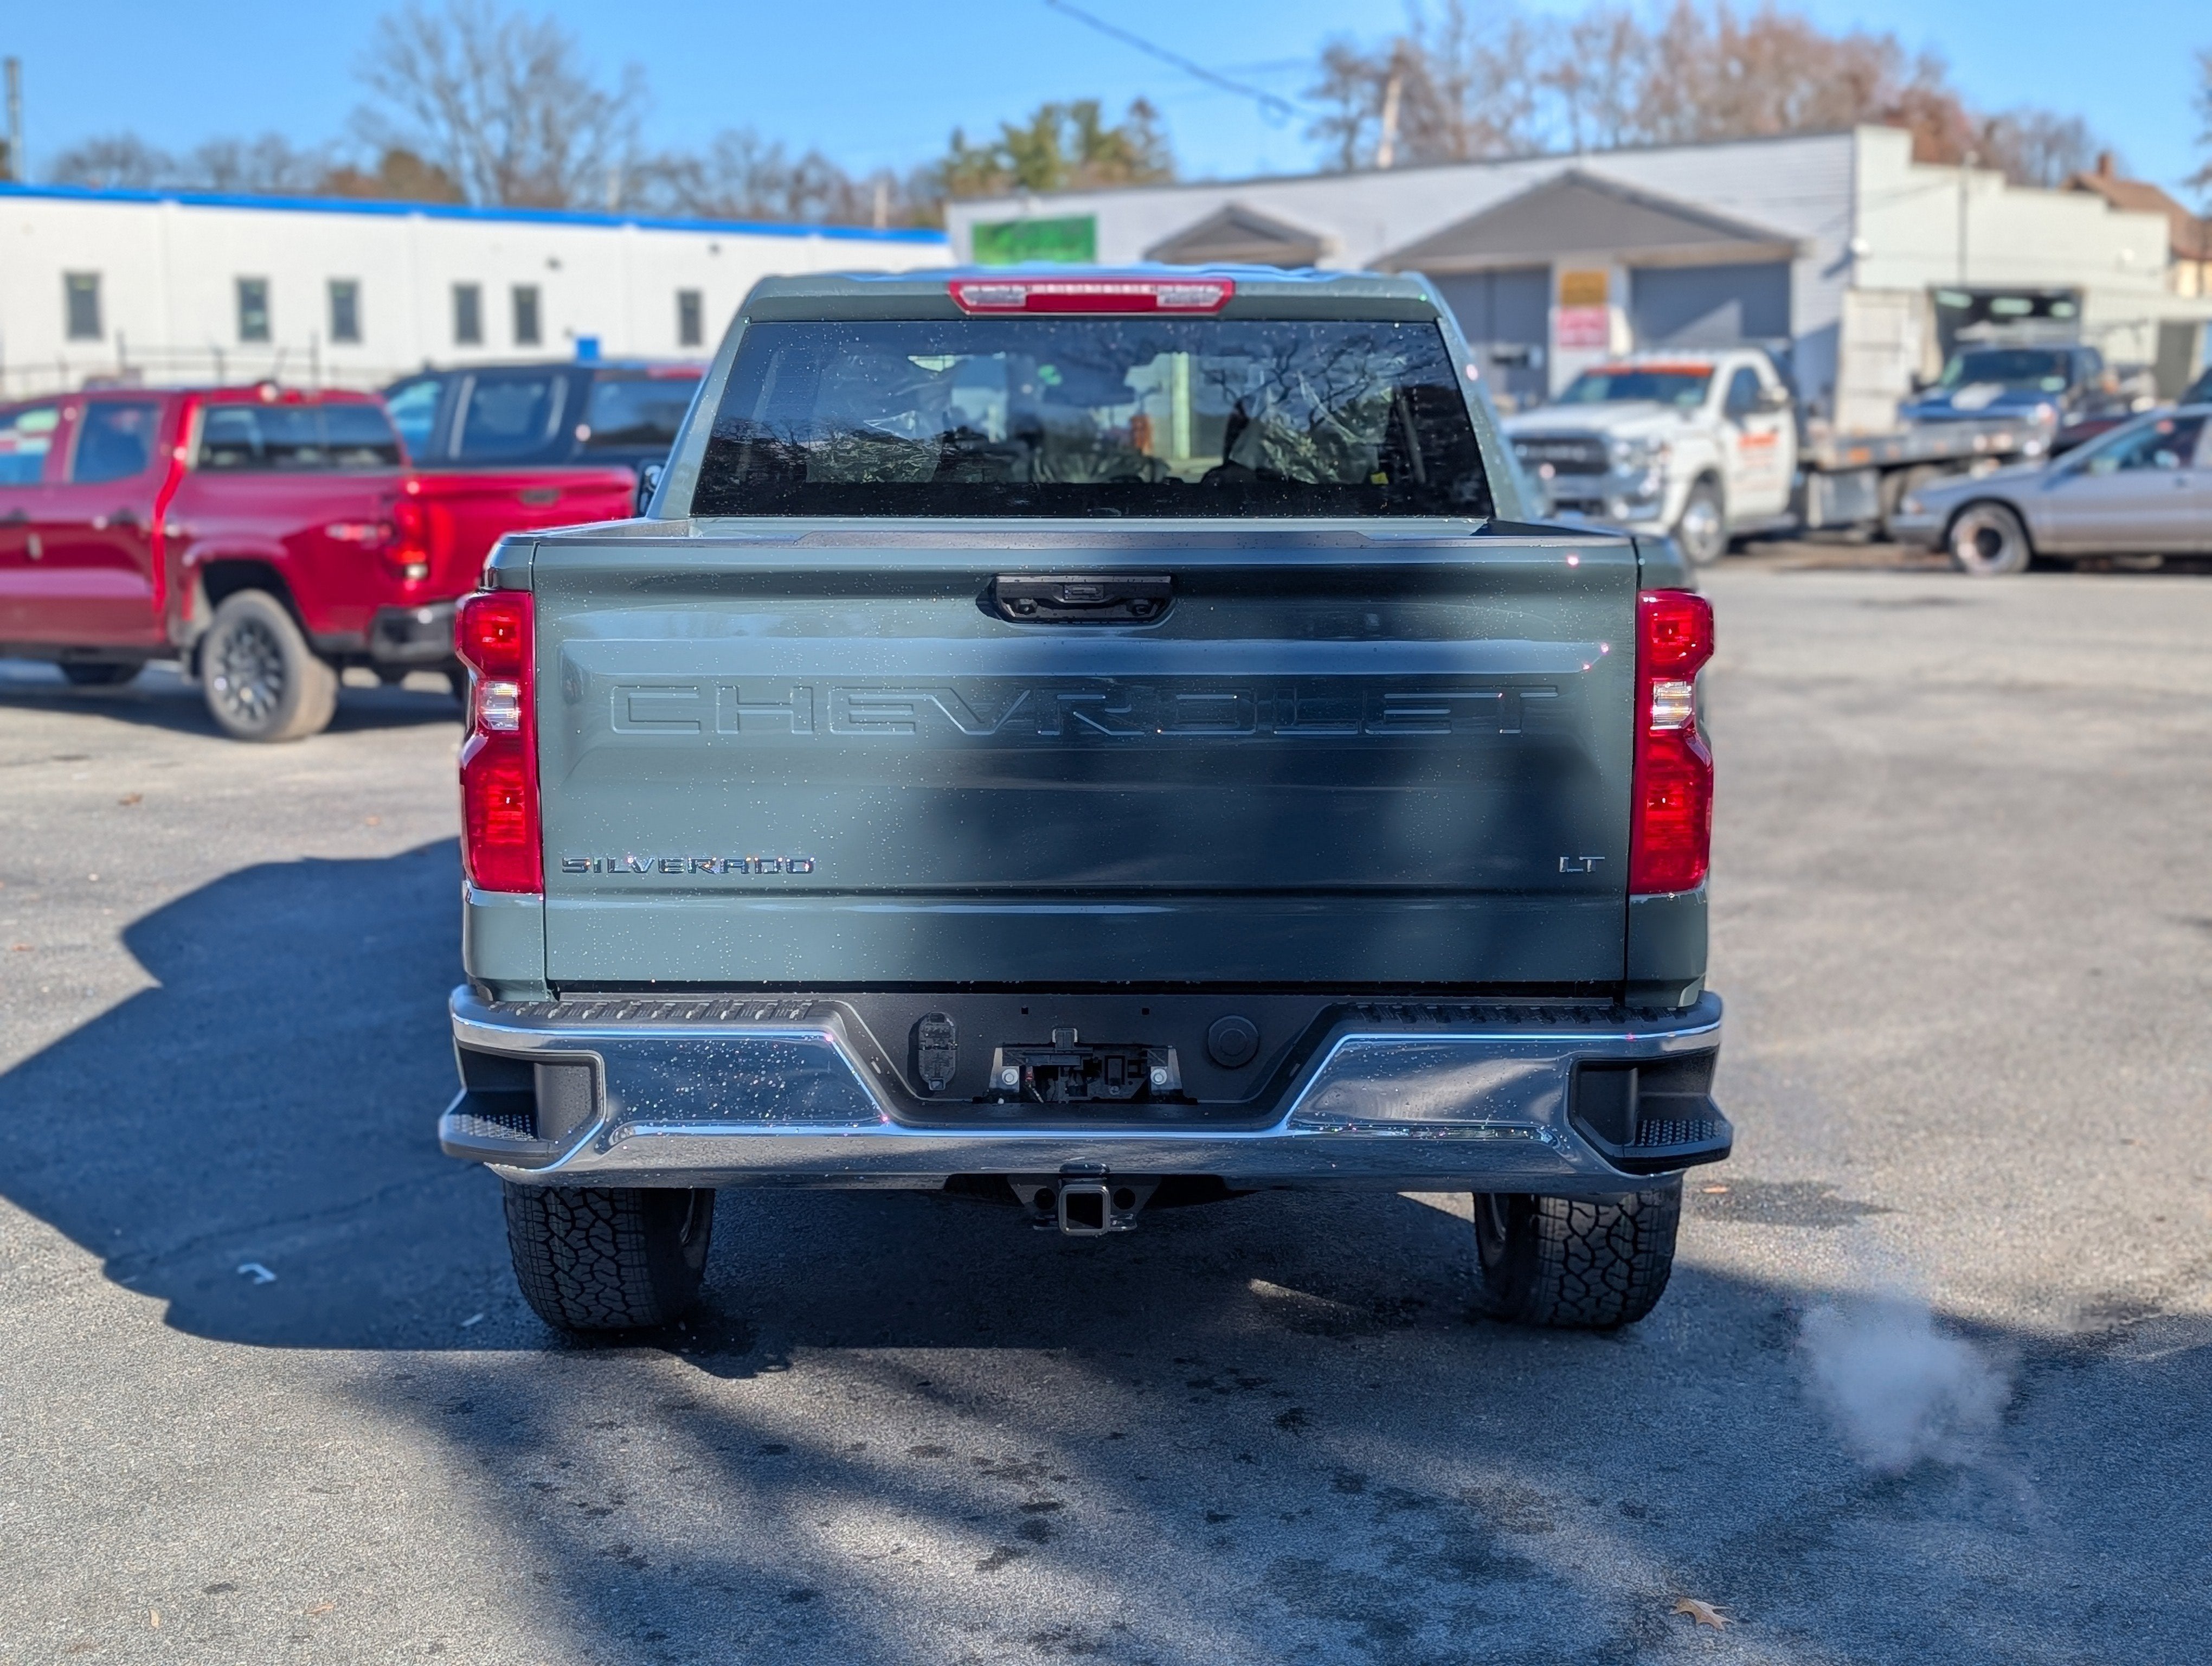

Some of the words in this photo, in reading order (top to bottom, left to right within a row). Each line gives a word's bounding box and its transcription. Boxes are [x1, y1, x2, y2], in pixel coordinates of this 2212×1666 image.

[611, 685, 1558, 734] CHEVROLET
[562, 856, 815, 875] SILVERADO
[1559, 856, 1605, 873] LT
